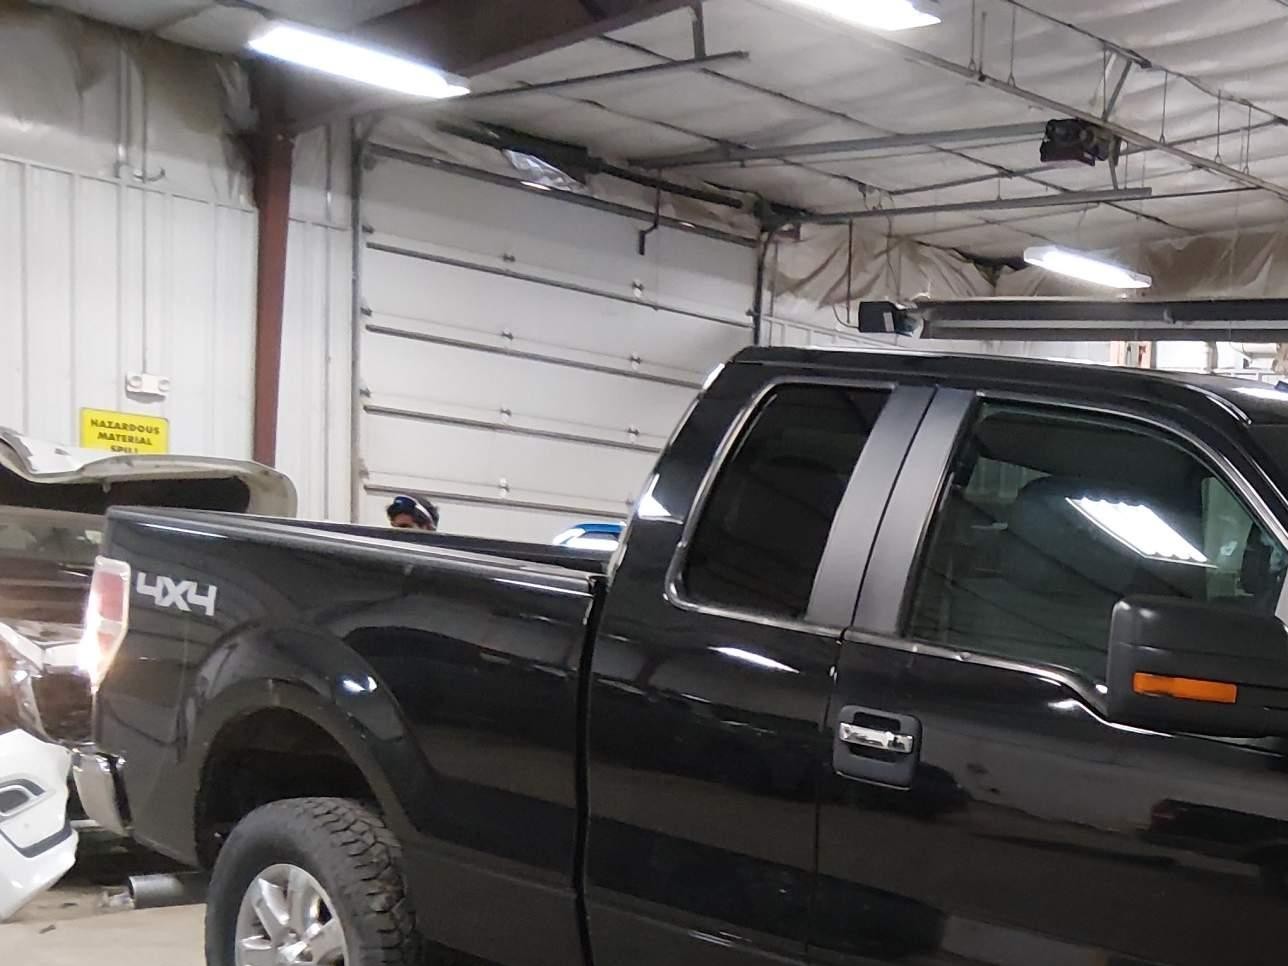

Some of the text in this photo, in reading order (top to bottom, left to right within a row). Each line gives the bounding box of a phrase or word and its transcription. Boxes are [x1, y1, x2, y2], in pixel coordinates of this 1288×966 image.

[90, 418, 160, 435] HAZARDOUS
[97, 431, 152, 446] MATERIAL
[136, 572, 217, 617] 4X4
